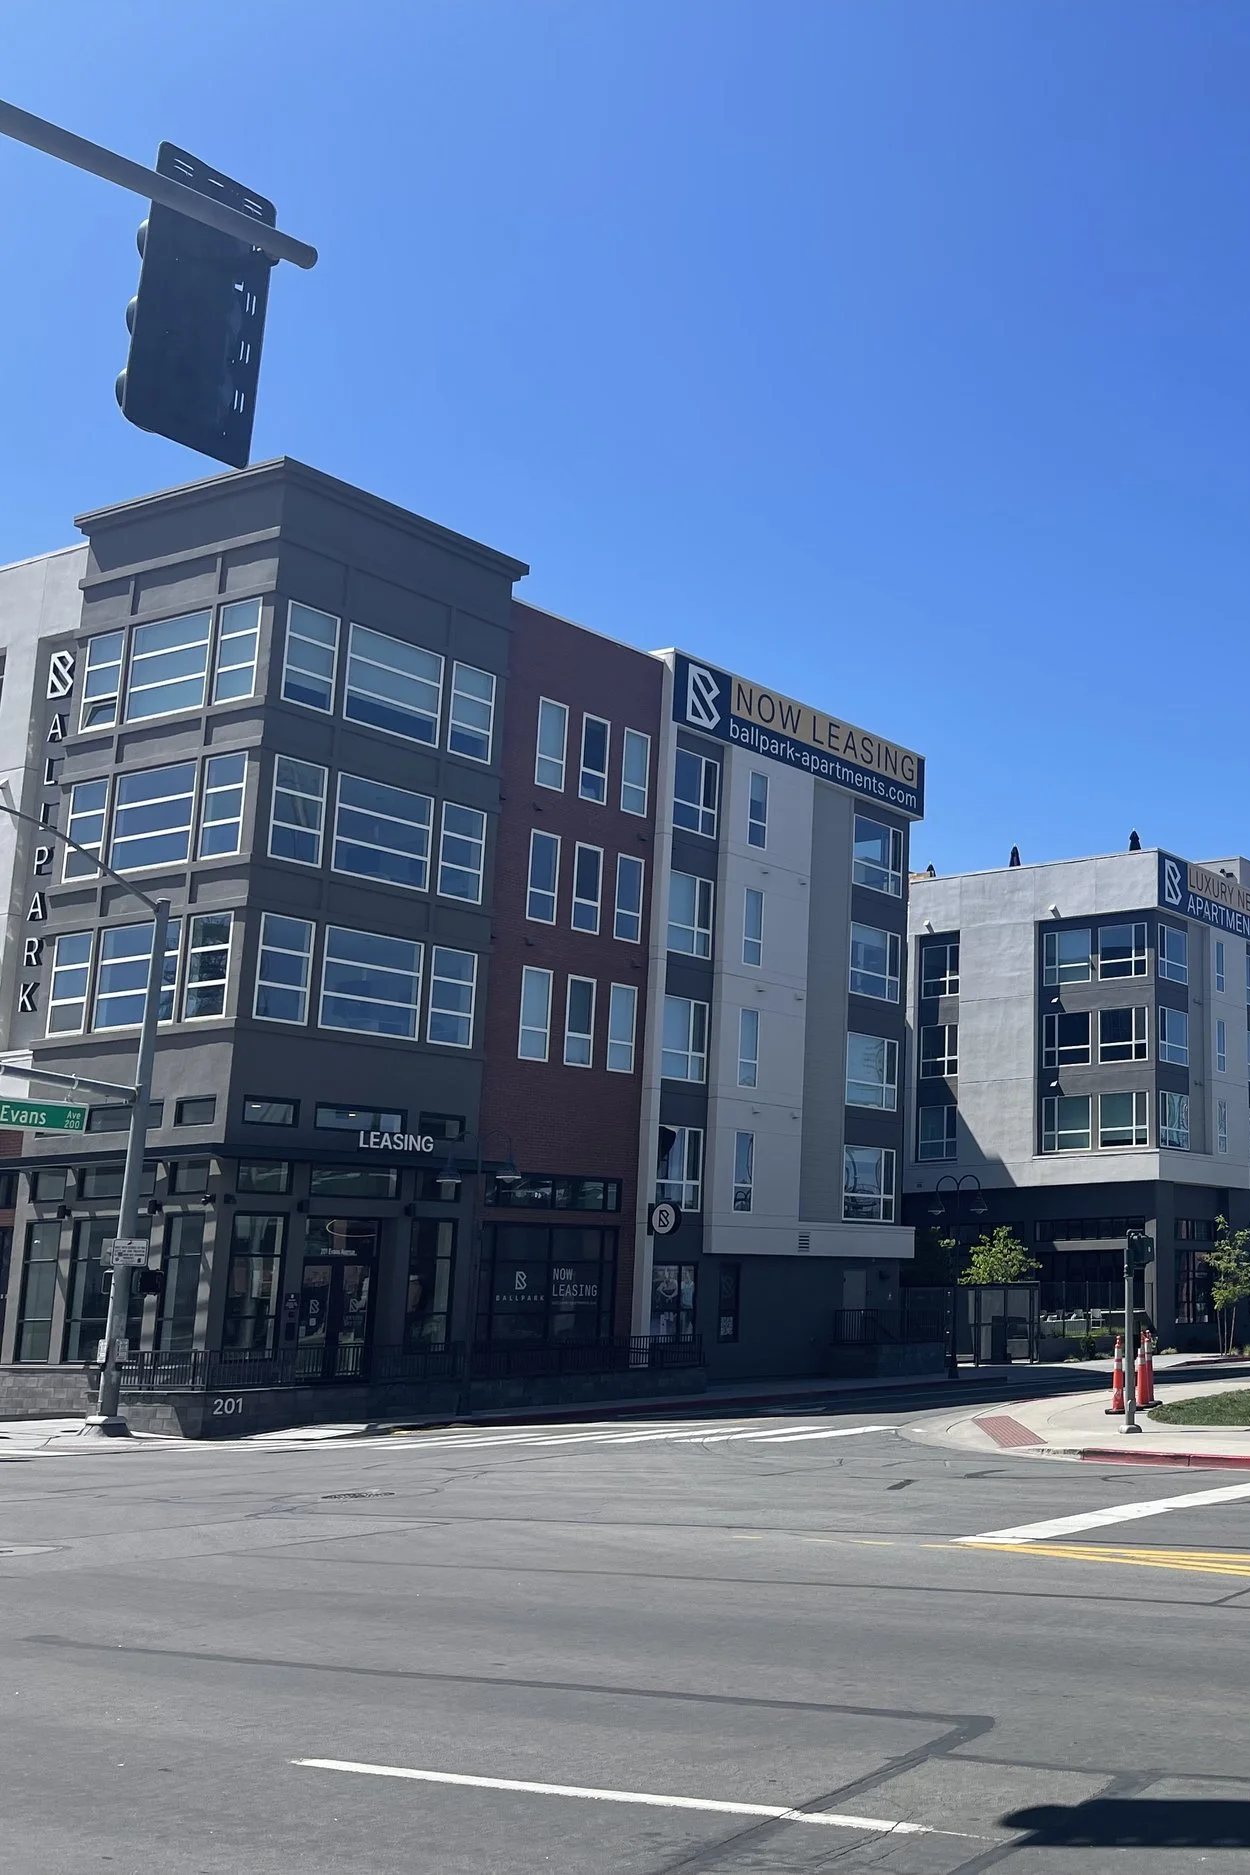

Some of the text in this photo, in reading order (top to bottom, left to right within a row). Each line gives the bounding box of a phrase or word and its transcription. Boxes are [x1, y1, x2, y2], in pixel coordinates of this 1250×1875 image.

[737, 683, 915, 782] NOW LEASING
[729, 718, 917, 809] ballpark-apartments.com
[1189, 867, 1234, 905] LUXURY
[0, 1104, 47, 1125] Evans
[67, 1110, 81, 1120] Ave
[64, 1120, 80, 1129] 200
[359, 1130, 434, 1153] LEASING
[553, 1268, 574, 1281] NOW
[552, 1284, 598, 1297] LEASING
[212, 1397, 243, 1415] 201
